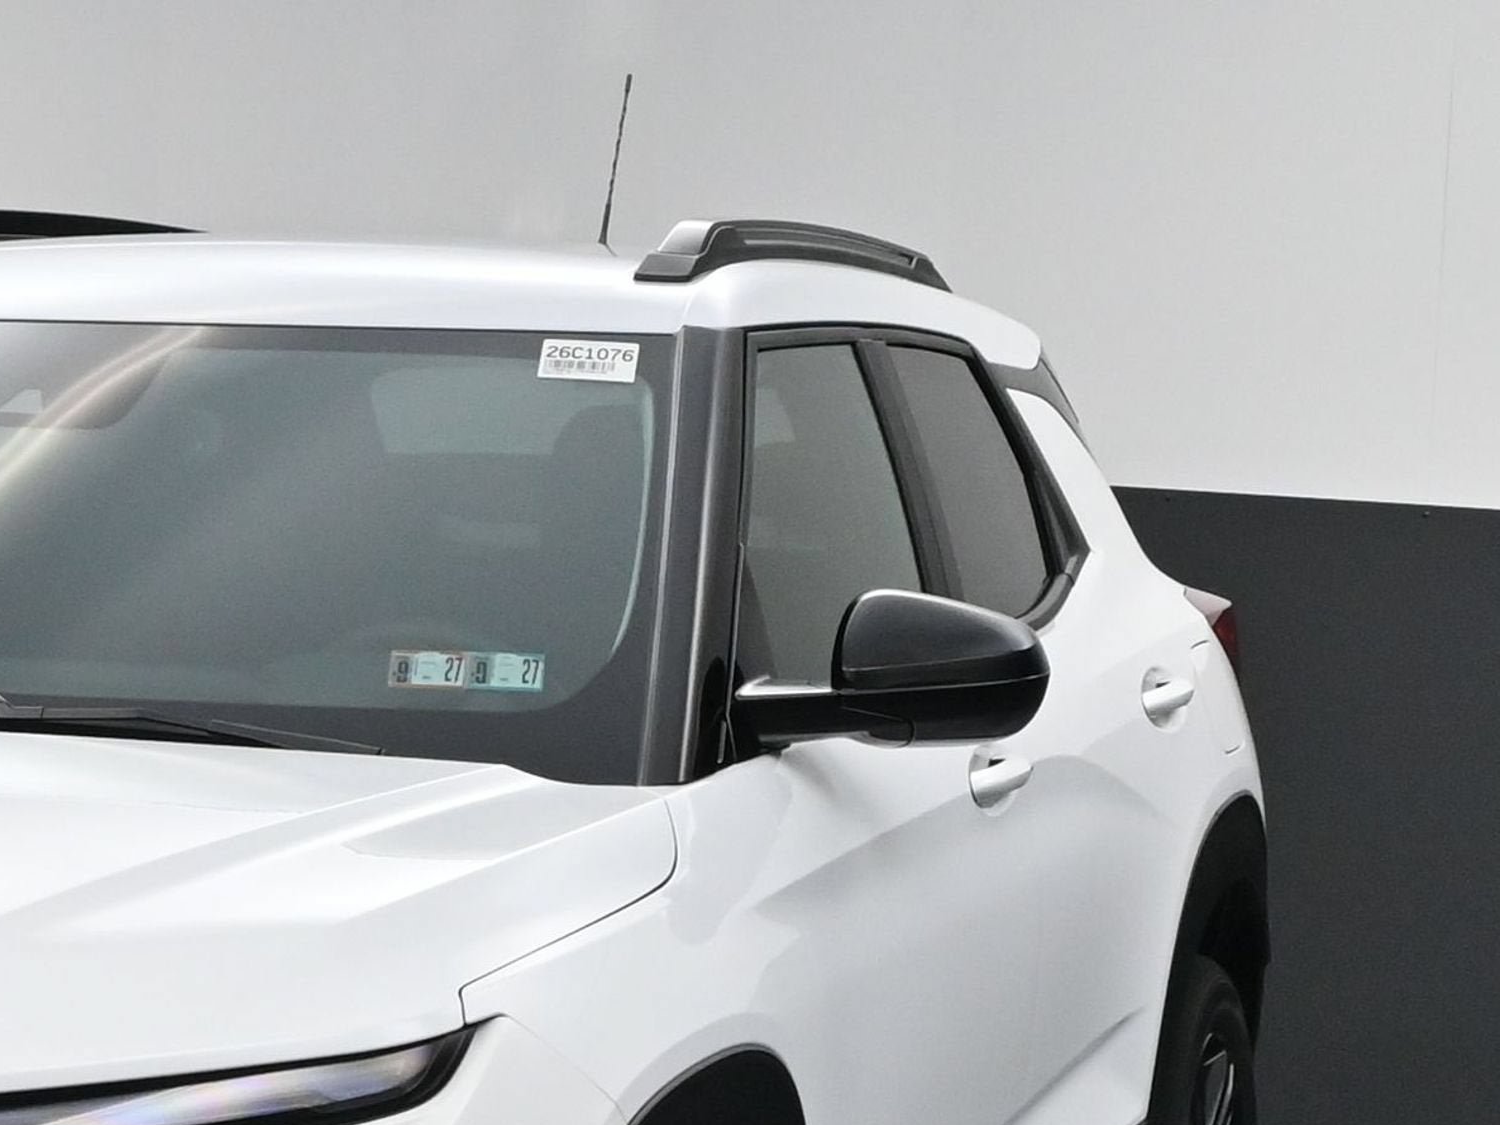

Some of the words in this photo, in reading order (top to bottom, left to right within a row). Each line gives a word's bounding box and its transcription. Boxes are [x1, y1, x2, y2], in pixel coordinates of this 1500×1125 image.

[546, 346, 635, 362] 26C1076
[444, 657, 463, 683] 27
[521, 659, 540, 685] 27
